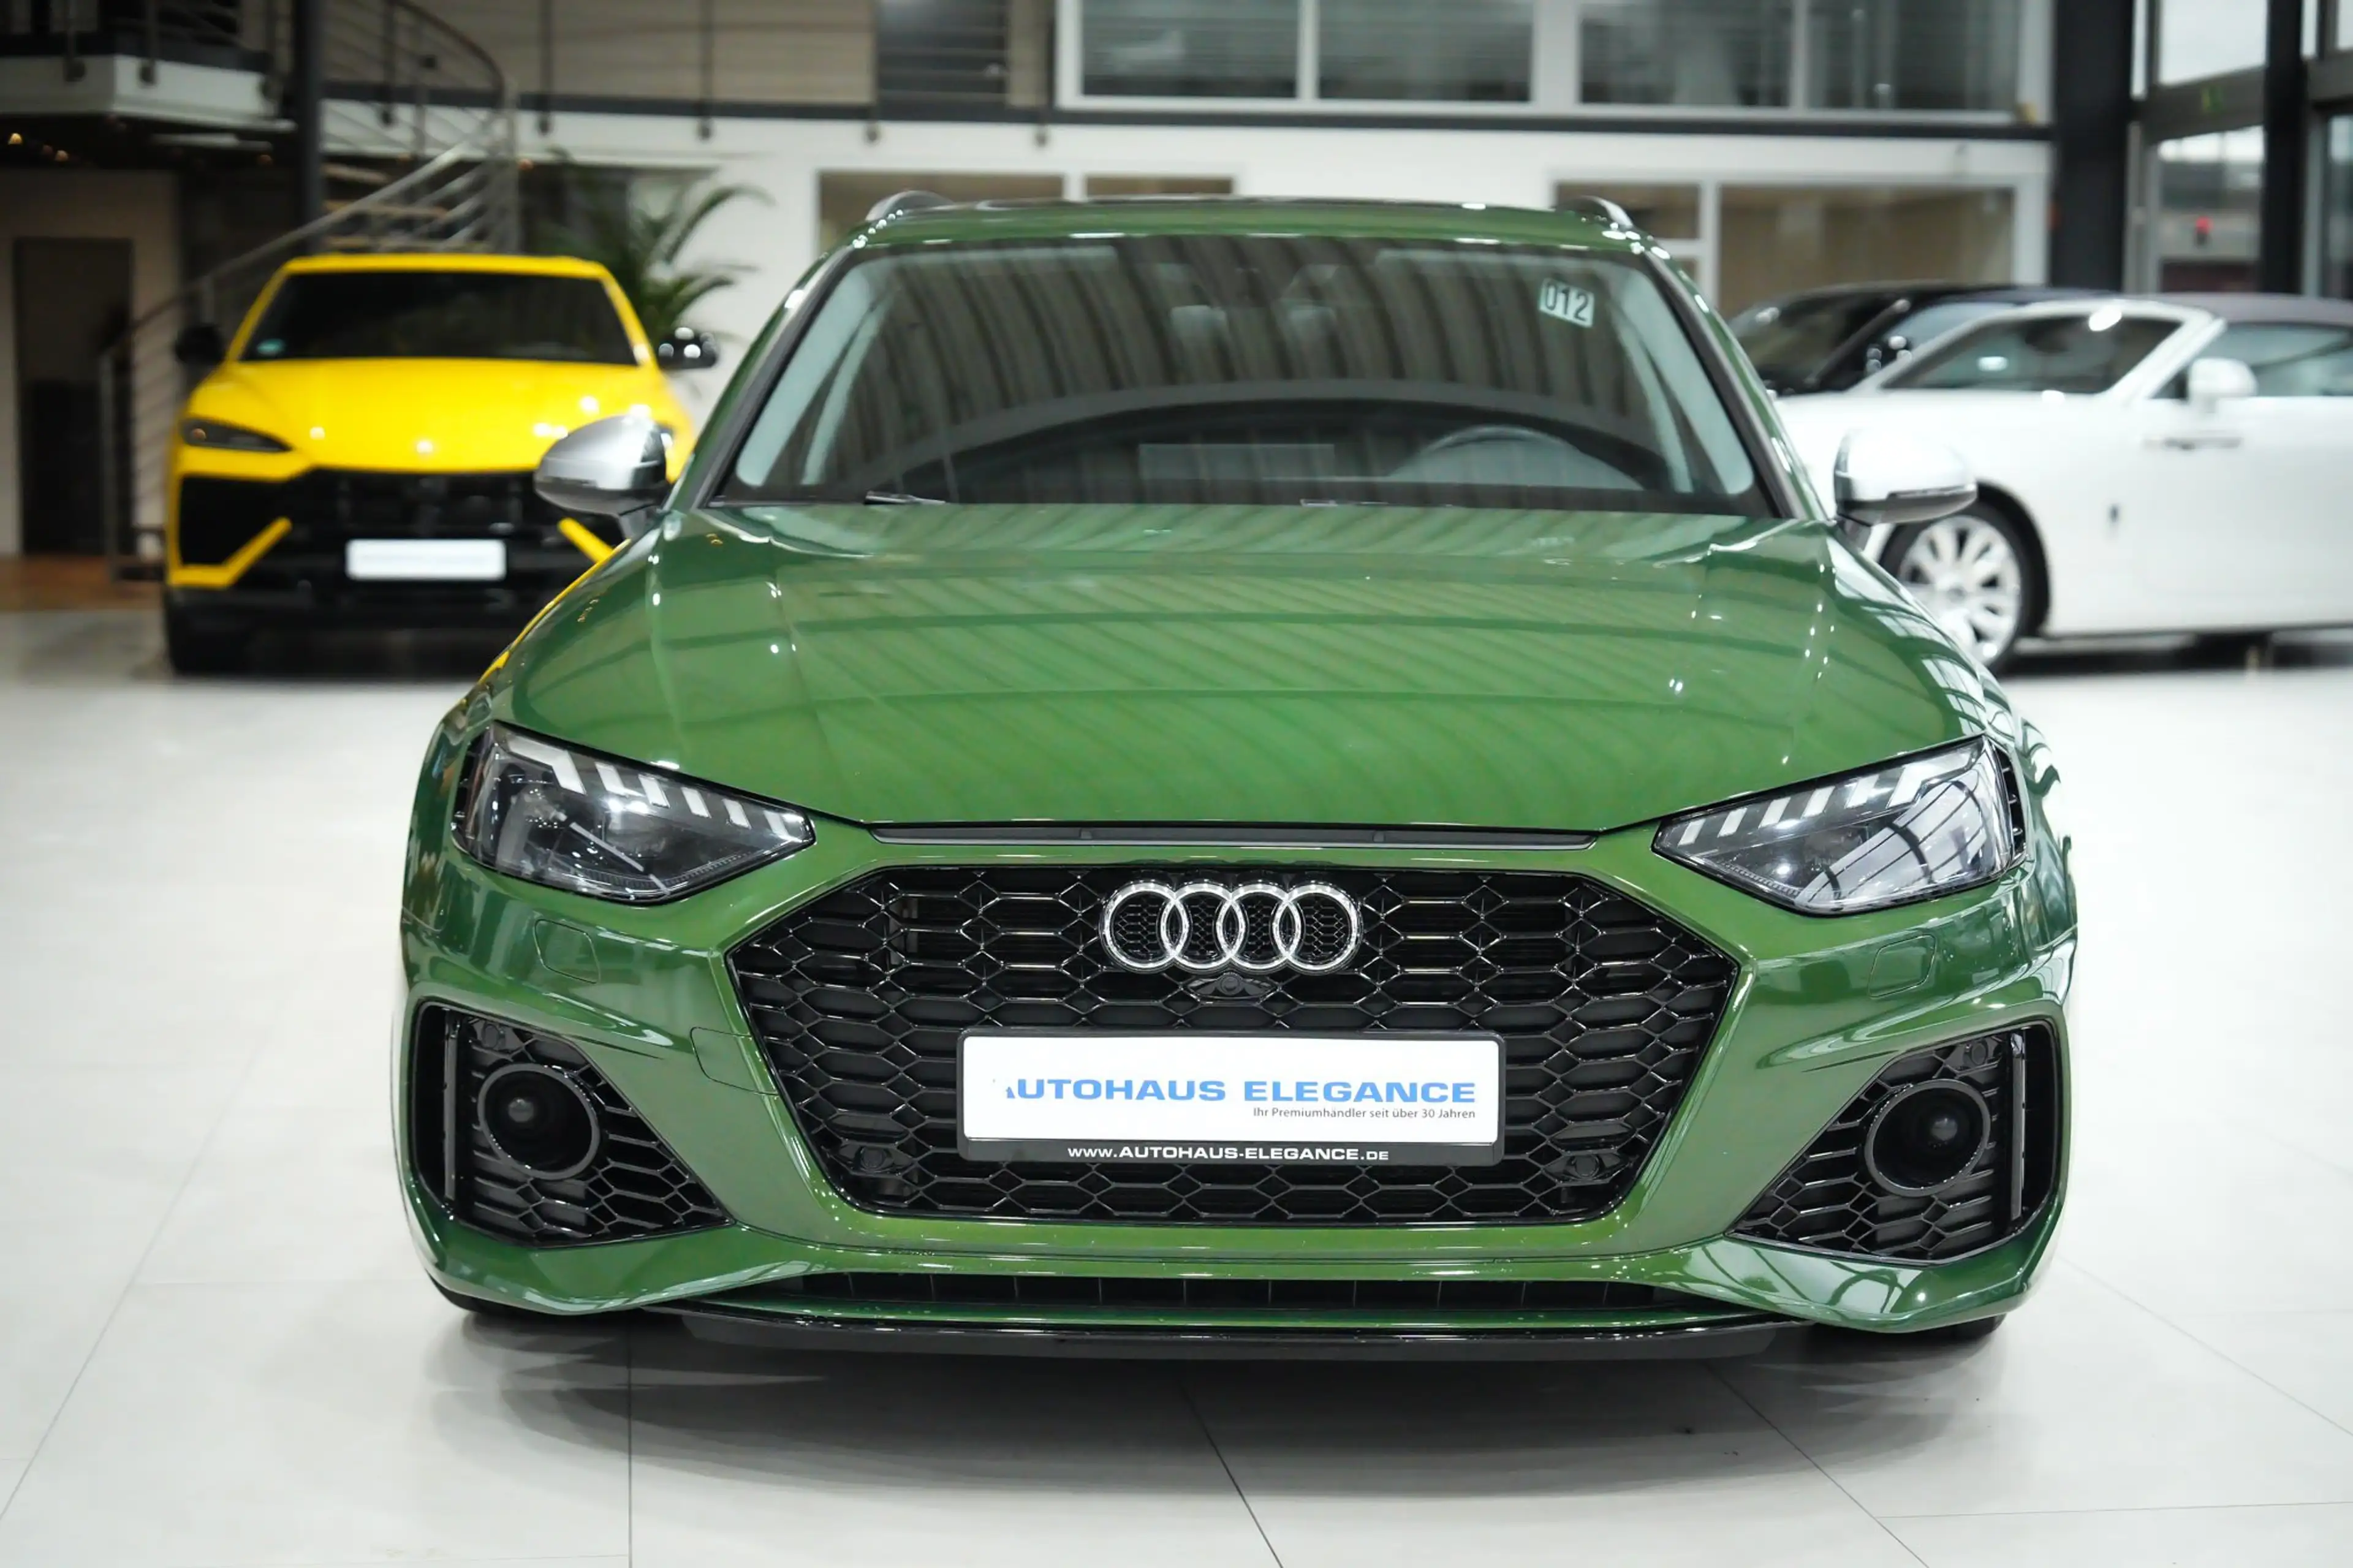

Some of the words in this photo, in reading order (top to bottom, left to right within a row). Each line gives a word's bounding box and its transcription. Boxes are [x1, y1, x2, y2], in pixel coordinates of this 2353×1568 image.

[1545, 282, 1589, 322] 012
[1244, 1080, 1476, 1104] ELEGANCE
[1253, 1107, 1268, 1117] Ihr
[1271, 1107, 1367, 1118] Premiumhändler
[1370, 1108, 1389, 1118] seit
[1392, 1108, 1418, 1118] über
[1422, 1108, 1436, 1119] 30
[1438, 1108, 1476, 1119] Jahren
[1067, 1146, 1389, 1161] www.AUTOHAUS-ELEGANCE.DE
